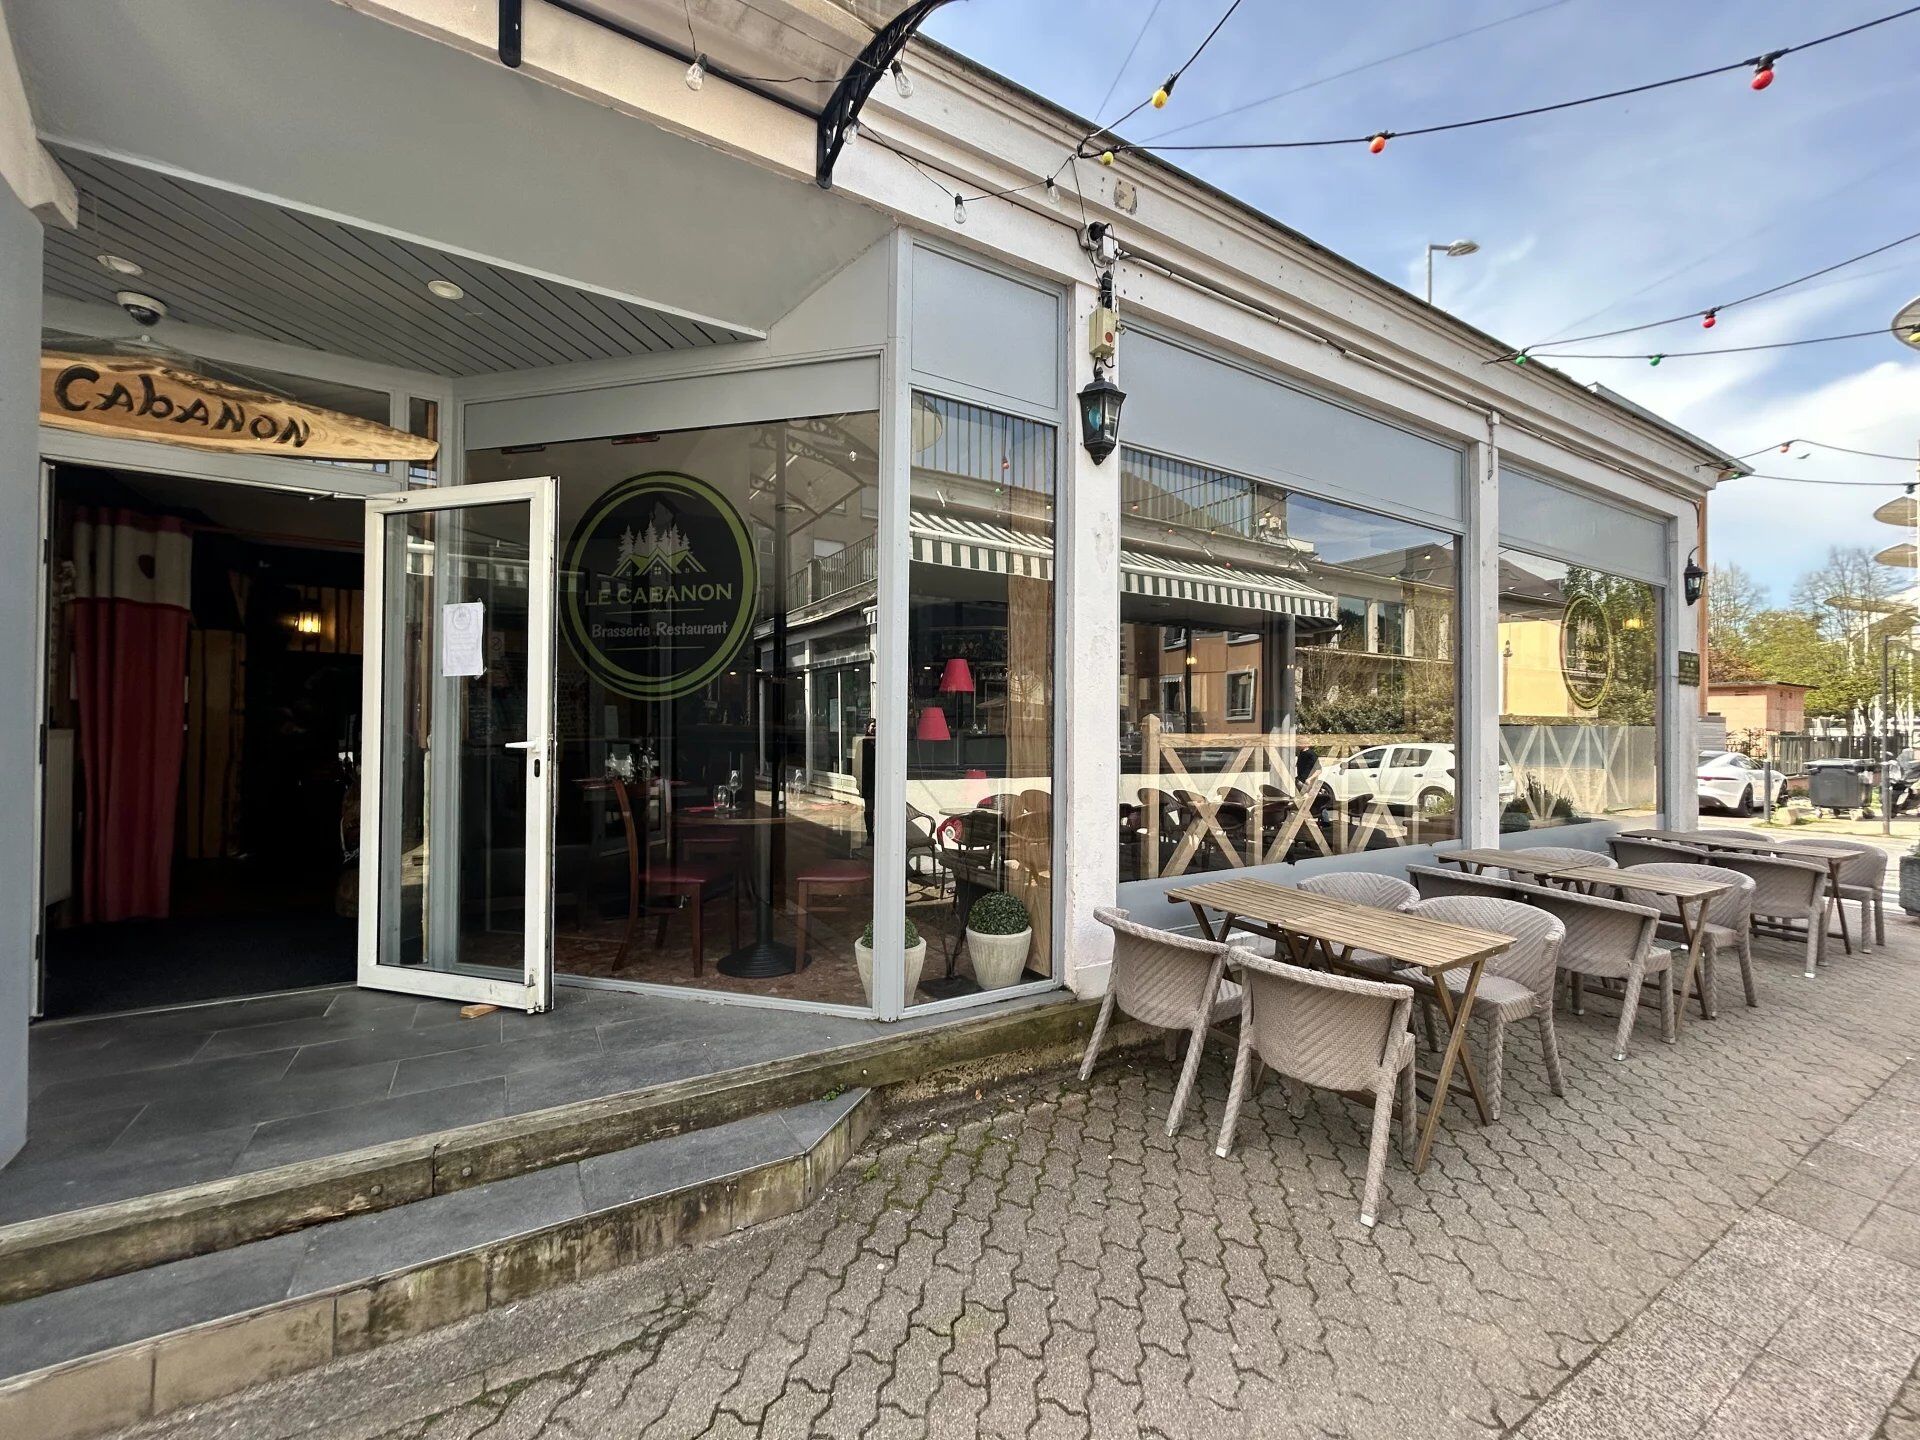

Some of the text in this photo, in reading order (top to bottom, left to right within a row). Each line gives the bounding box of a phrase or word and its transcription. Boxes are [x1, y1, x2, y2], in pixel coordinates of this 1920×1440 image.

[585, 583, 732, 606] LE CABANON
[591, 621, 728, 638] Brasserie Restaurant
